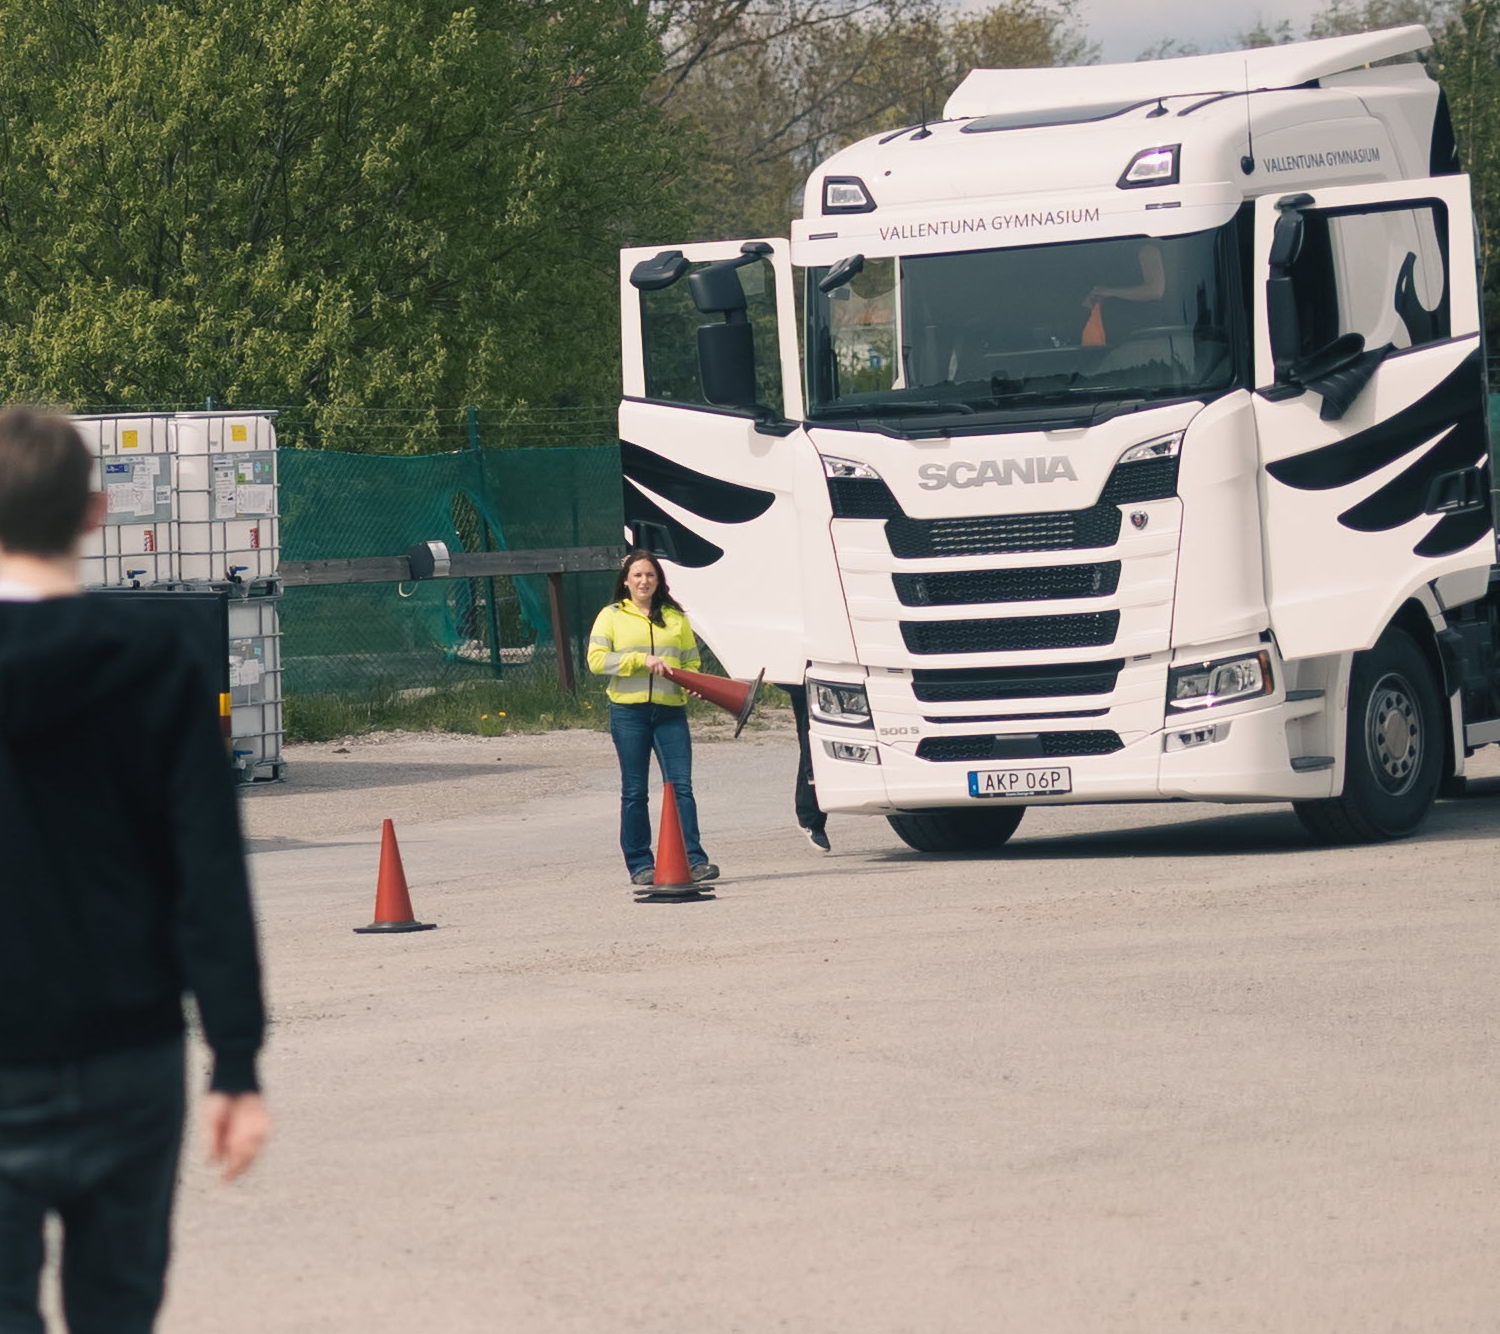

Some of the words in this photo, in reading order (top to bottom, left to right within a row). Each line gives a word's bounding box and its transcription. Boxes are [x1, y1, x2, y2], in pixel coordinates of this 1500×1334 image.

[1263, 153, 1325, 173] VALLENTUNA
[1325, 147, 1381, 167] GYMNASIUM
[879, 217, 987, 241] VALLENTUNA
[991, 207, 1100, 231] GYMNASIUM
[917, 455, 1079, 491] SCANIA
[880, 727, 908, 736] 500
[910, 726, 920, 735] S
[985, 773, 1019, 791] AKP
[1026, 771, 1062, 789] 06P
